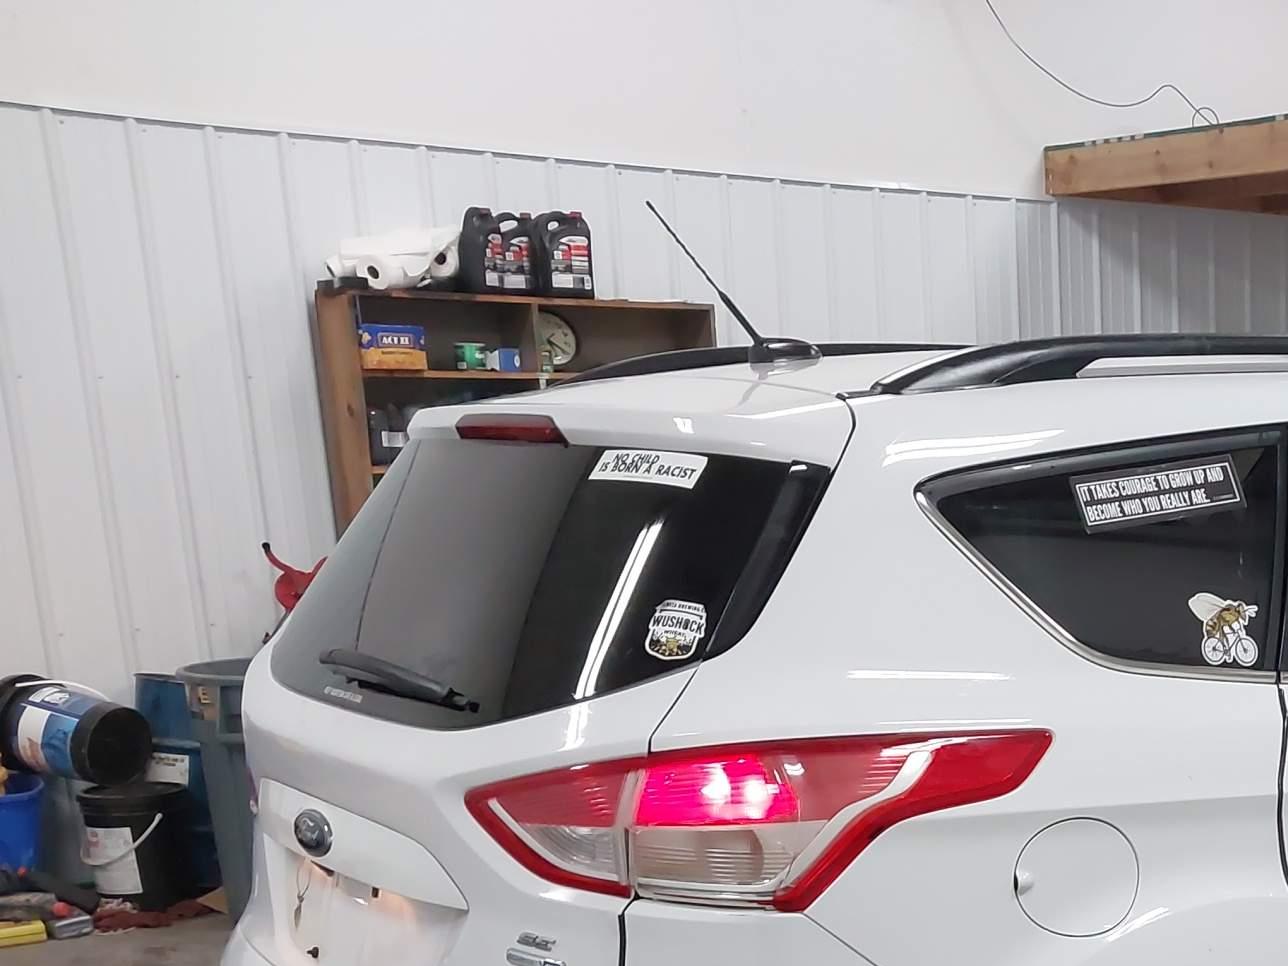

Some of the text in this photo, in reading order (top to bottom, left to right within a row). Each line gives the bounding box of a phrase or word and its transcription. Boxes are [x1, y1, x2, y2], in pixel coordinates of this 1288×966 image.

[598, 461, 698, 480] IS BORN A RACIST
[611, 453, 660, 466] NO CHILD
[1080, 467, 1224, 502] IT TAKES COURAGE TO GROW UP AND
[1086, 502, 1123, 522] BECOME
[1120, 498, 1143, 516] WHO
[1142, 497, 1161, 514] YOU
[1160, 491, 1192, 510] REALLY
[651, 615, 704, 637] WUSHOCK
